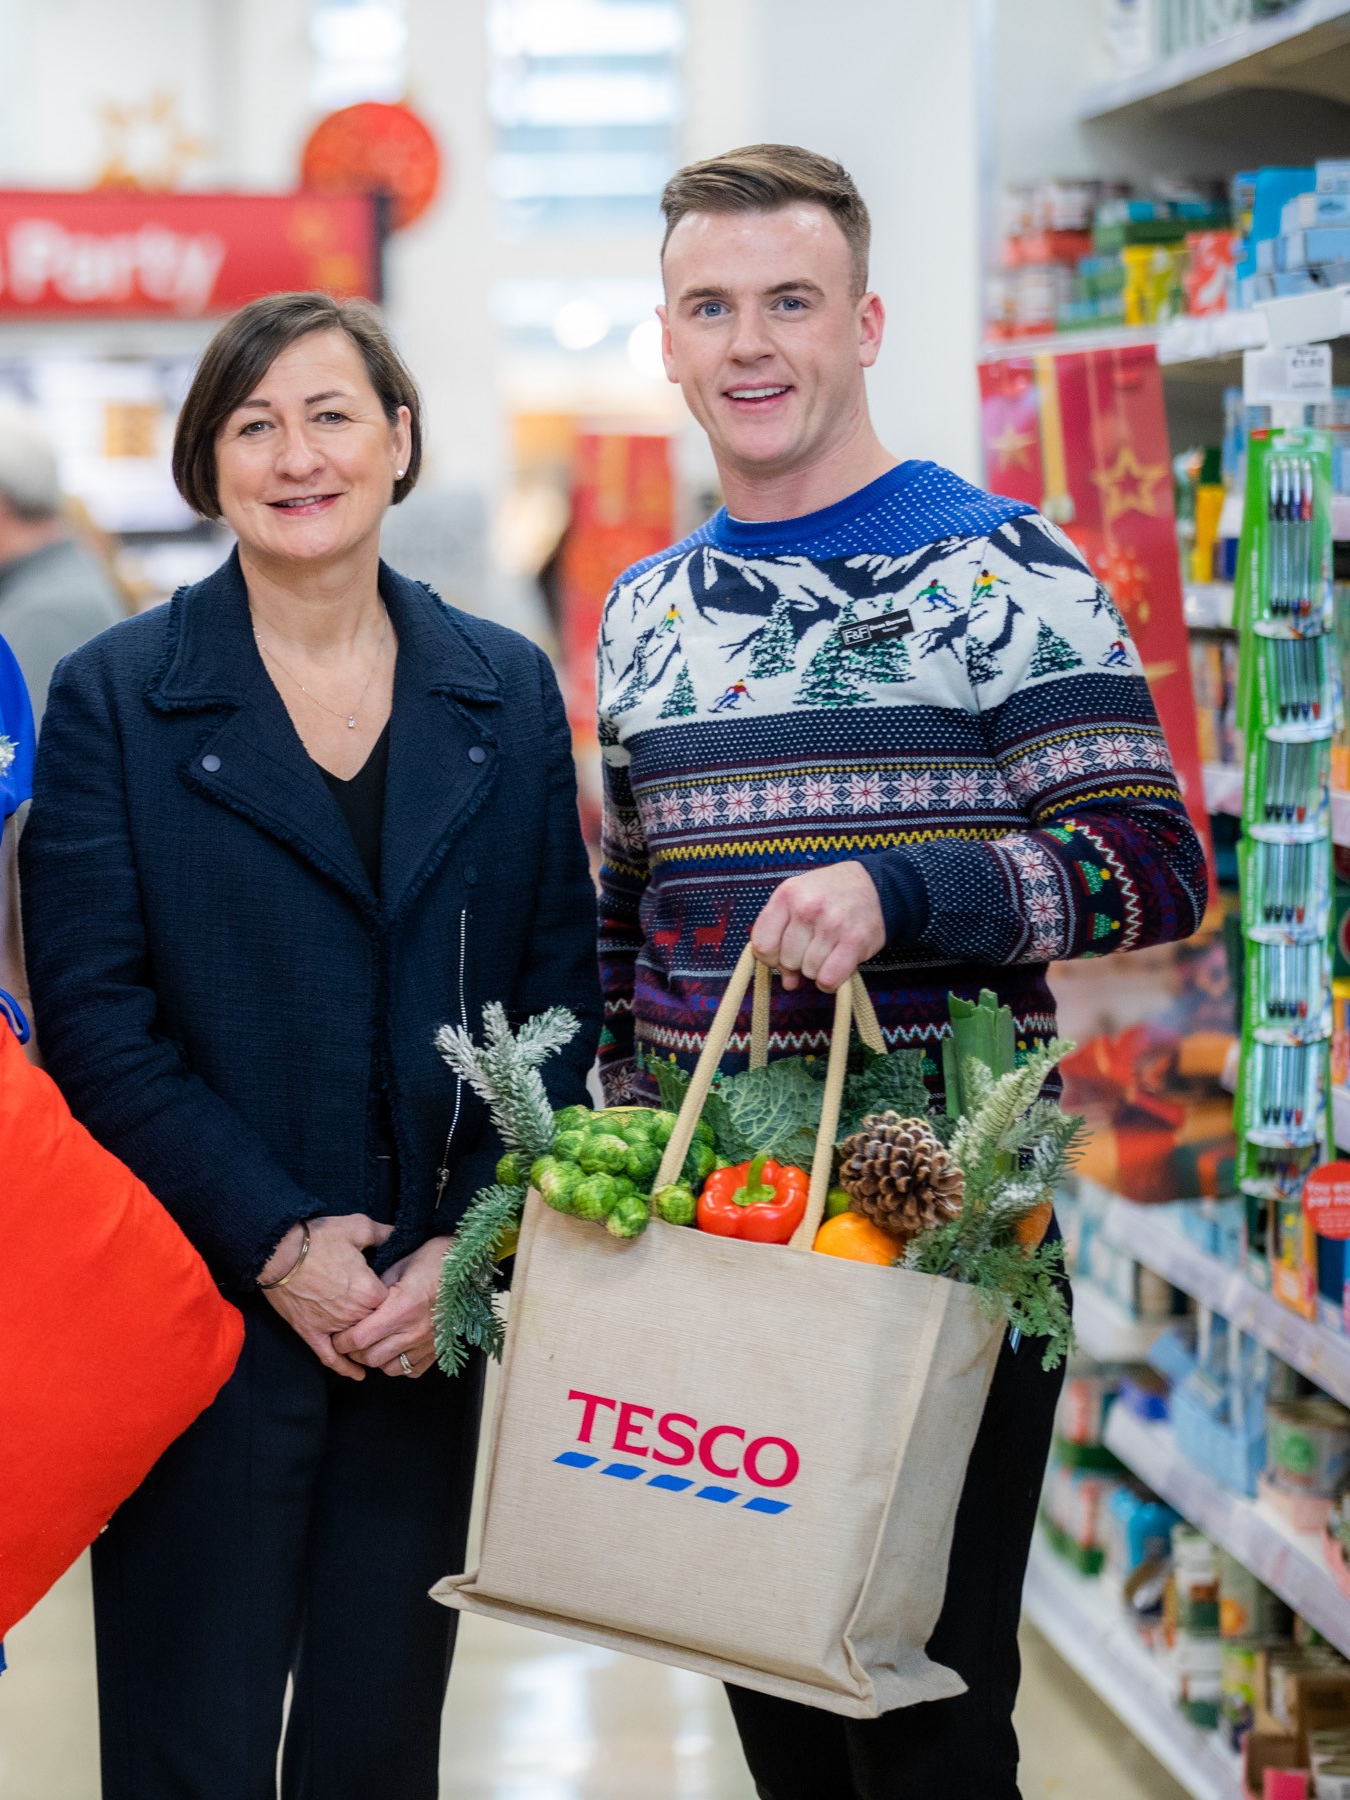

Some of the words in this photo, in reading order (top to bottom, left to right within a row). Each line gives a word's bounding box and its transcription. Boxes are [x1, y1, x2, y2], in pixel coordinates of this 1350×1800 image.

[7, 217, 226, 319] Party
[845, 626, 868, 643] F&F
[1305, 1181, 1331, 1196] You
[568, 1389, 800, 1488] TESCO
